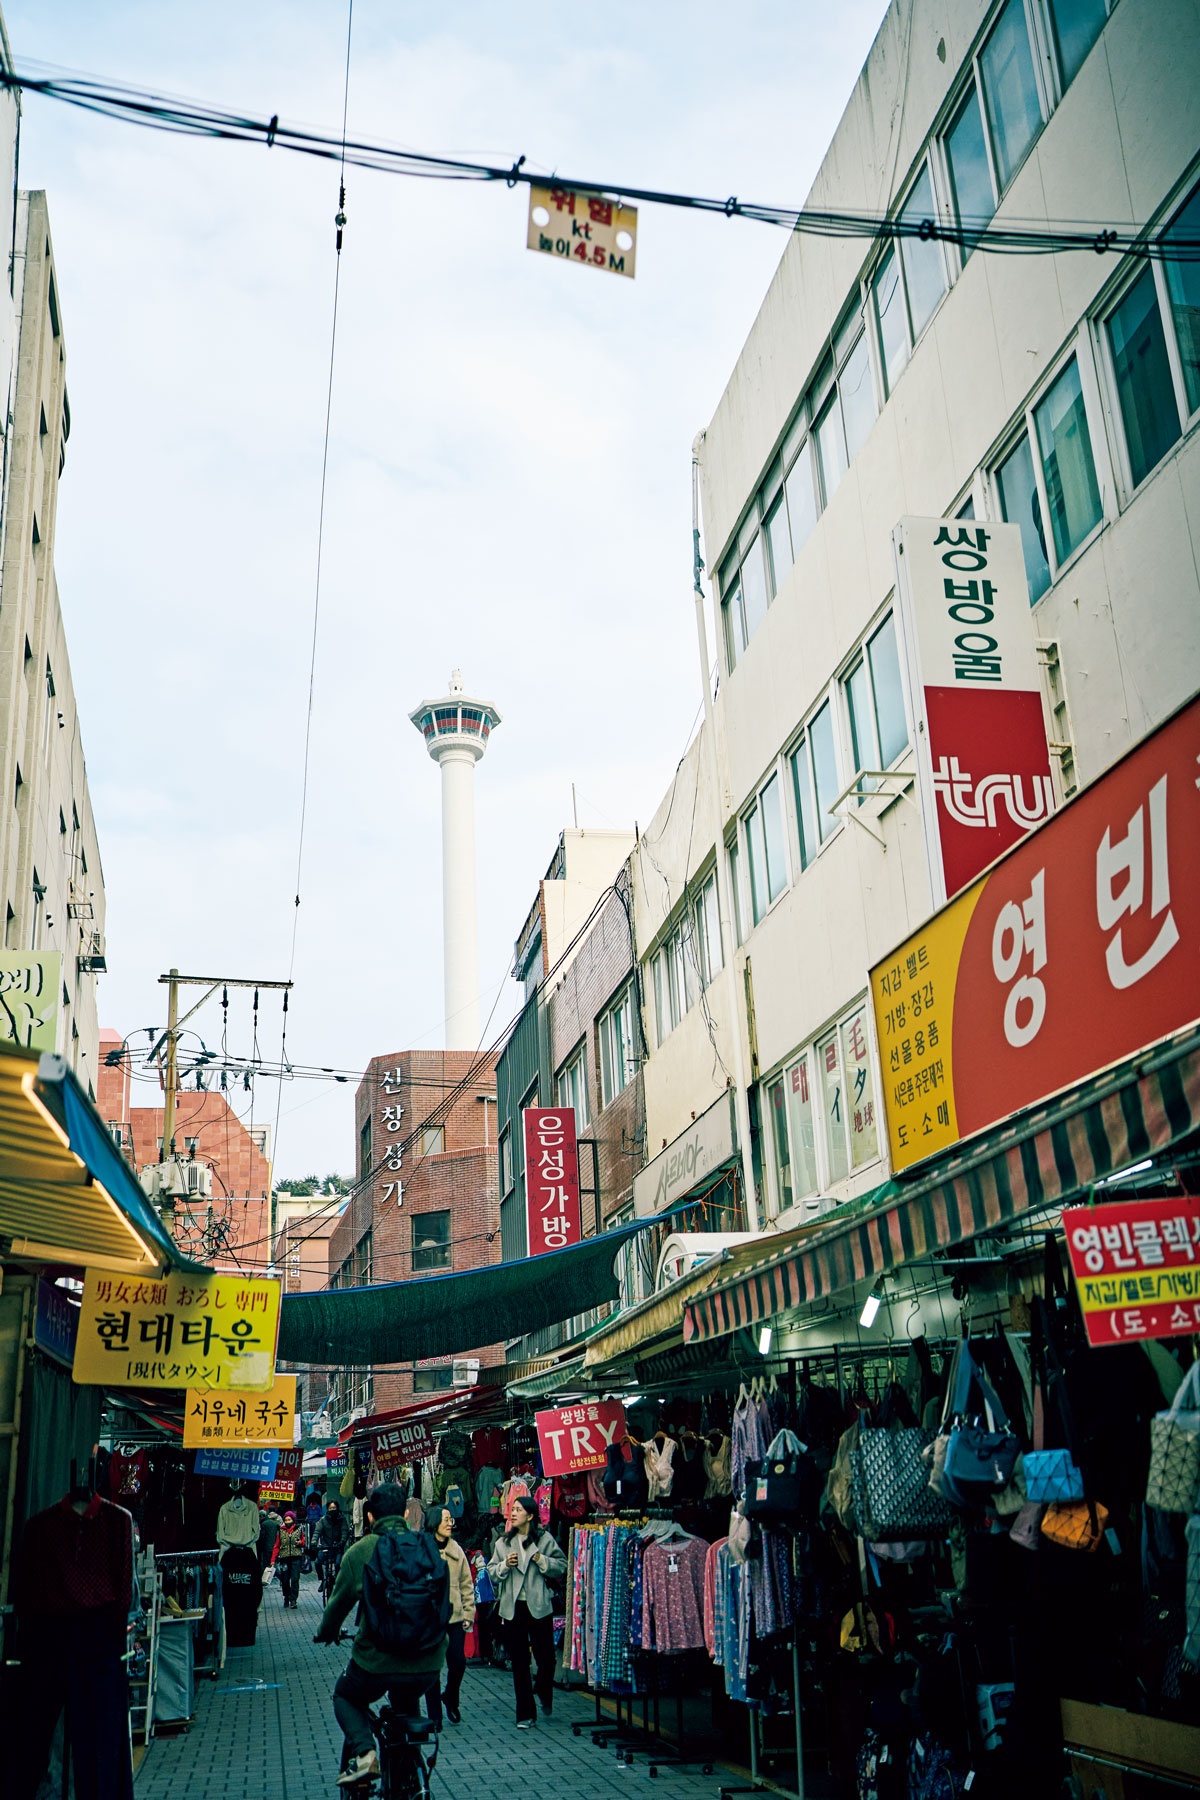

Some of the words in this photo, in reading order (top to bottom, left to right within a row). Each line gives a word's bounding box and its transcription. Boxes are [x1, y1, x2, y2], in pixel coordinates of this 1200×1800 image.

[933, 526, 1003, 682] 쌍방울
[890, 1020, 939, 1073] 선물용품
[380, 1067, 405, 1207] 신창상가
[537, 1116, 572, 1248] 은성가방
[96, 1280, 168, 1306] 男女衣類
[177, 1286, 227, 1309] おろし
[94, 1310, 261, 1357] 현대타운
[191, 1399, 246, 1425] 시우네
[254, 1400, 289, 1428] 국수
[560, 1406, 599, 1426] 쌍방울
[376, 1423, 428, 1452] 사르비아
[544, 1420, 618, 1460] TRY
